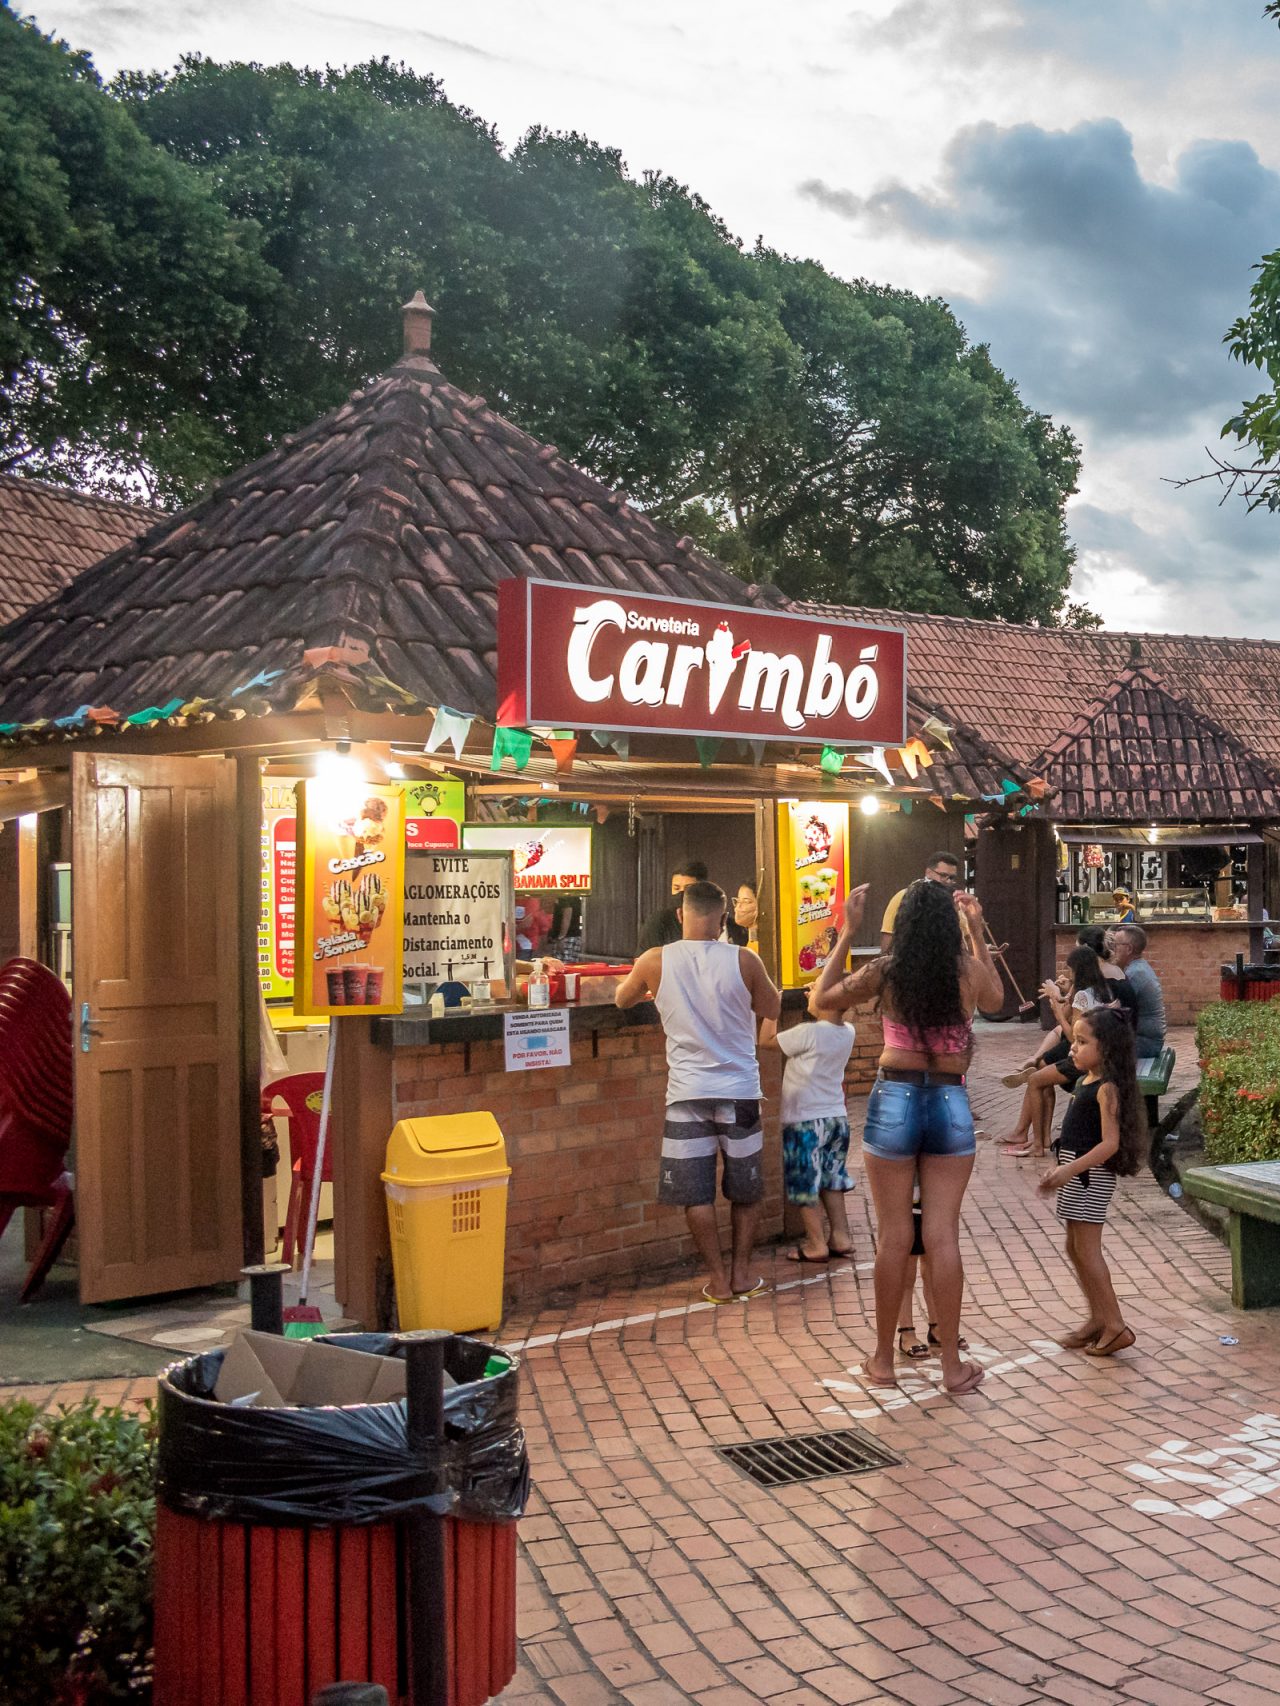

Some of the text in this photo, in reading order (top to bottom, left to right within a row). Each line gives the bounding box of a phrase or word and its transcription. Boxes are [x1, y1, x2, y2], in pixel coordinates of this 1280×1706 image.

[626, 610, 700, 637] Sorveteria
[567, 599, 879, 731] Carimbó
[328, 850, 386, 874] Cascão
[432, 858, 469, 873] EVITE
[795, 849, 829, 870] Sundae
[514, 874, 590, 889] BANANA SPLIT
[404, 881, 500, 902] AGLOMERAÇÕES
[403, 911, 470, 926] Mantenha o
[317, 932, 357, 950] Salada
[402, 936, 493, 952] Distanciamento
[402, 961, 440, 978] Social.
